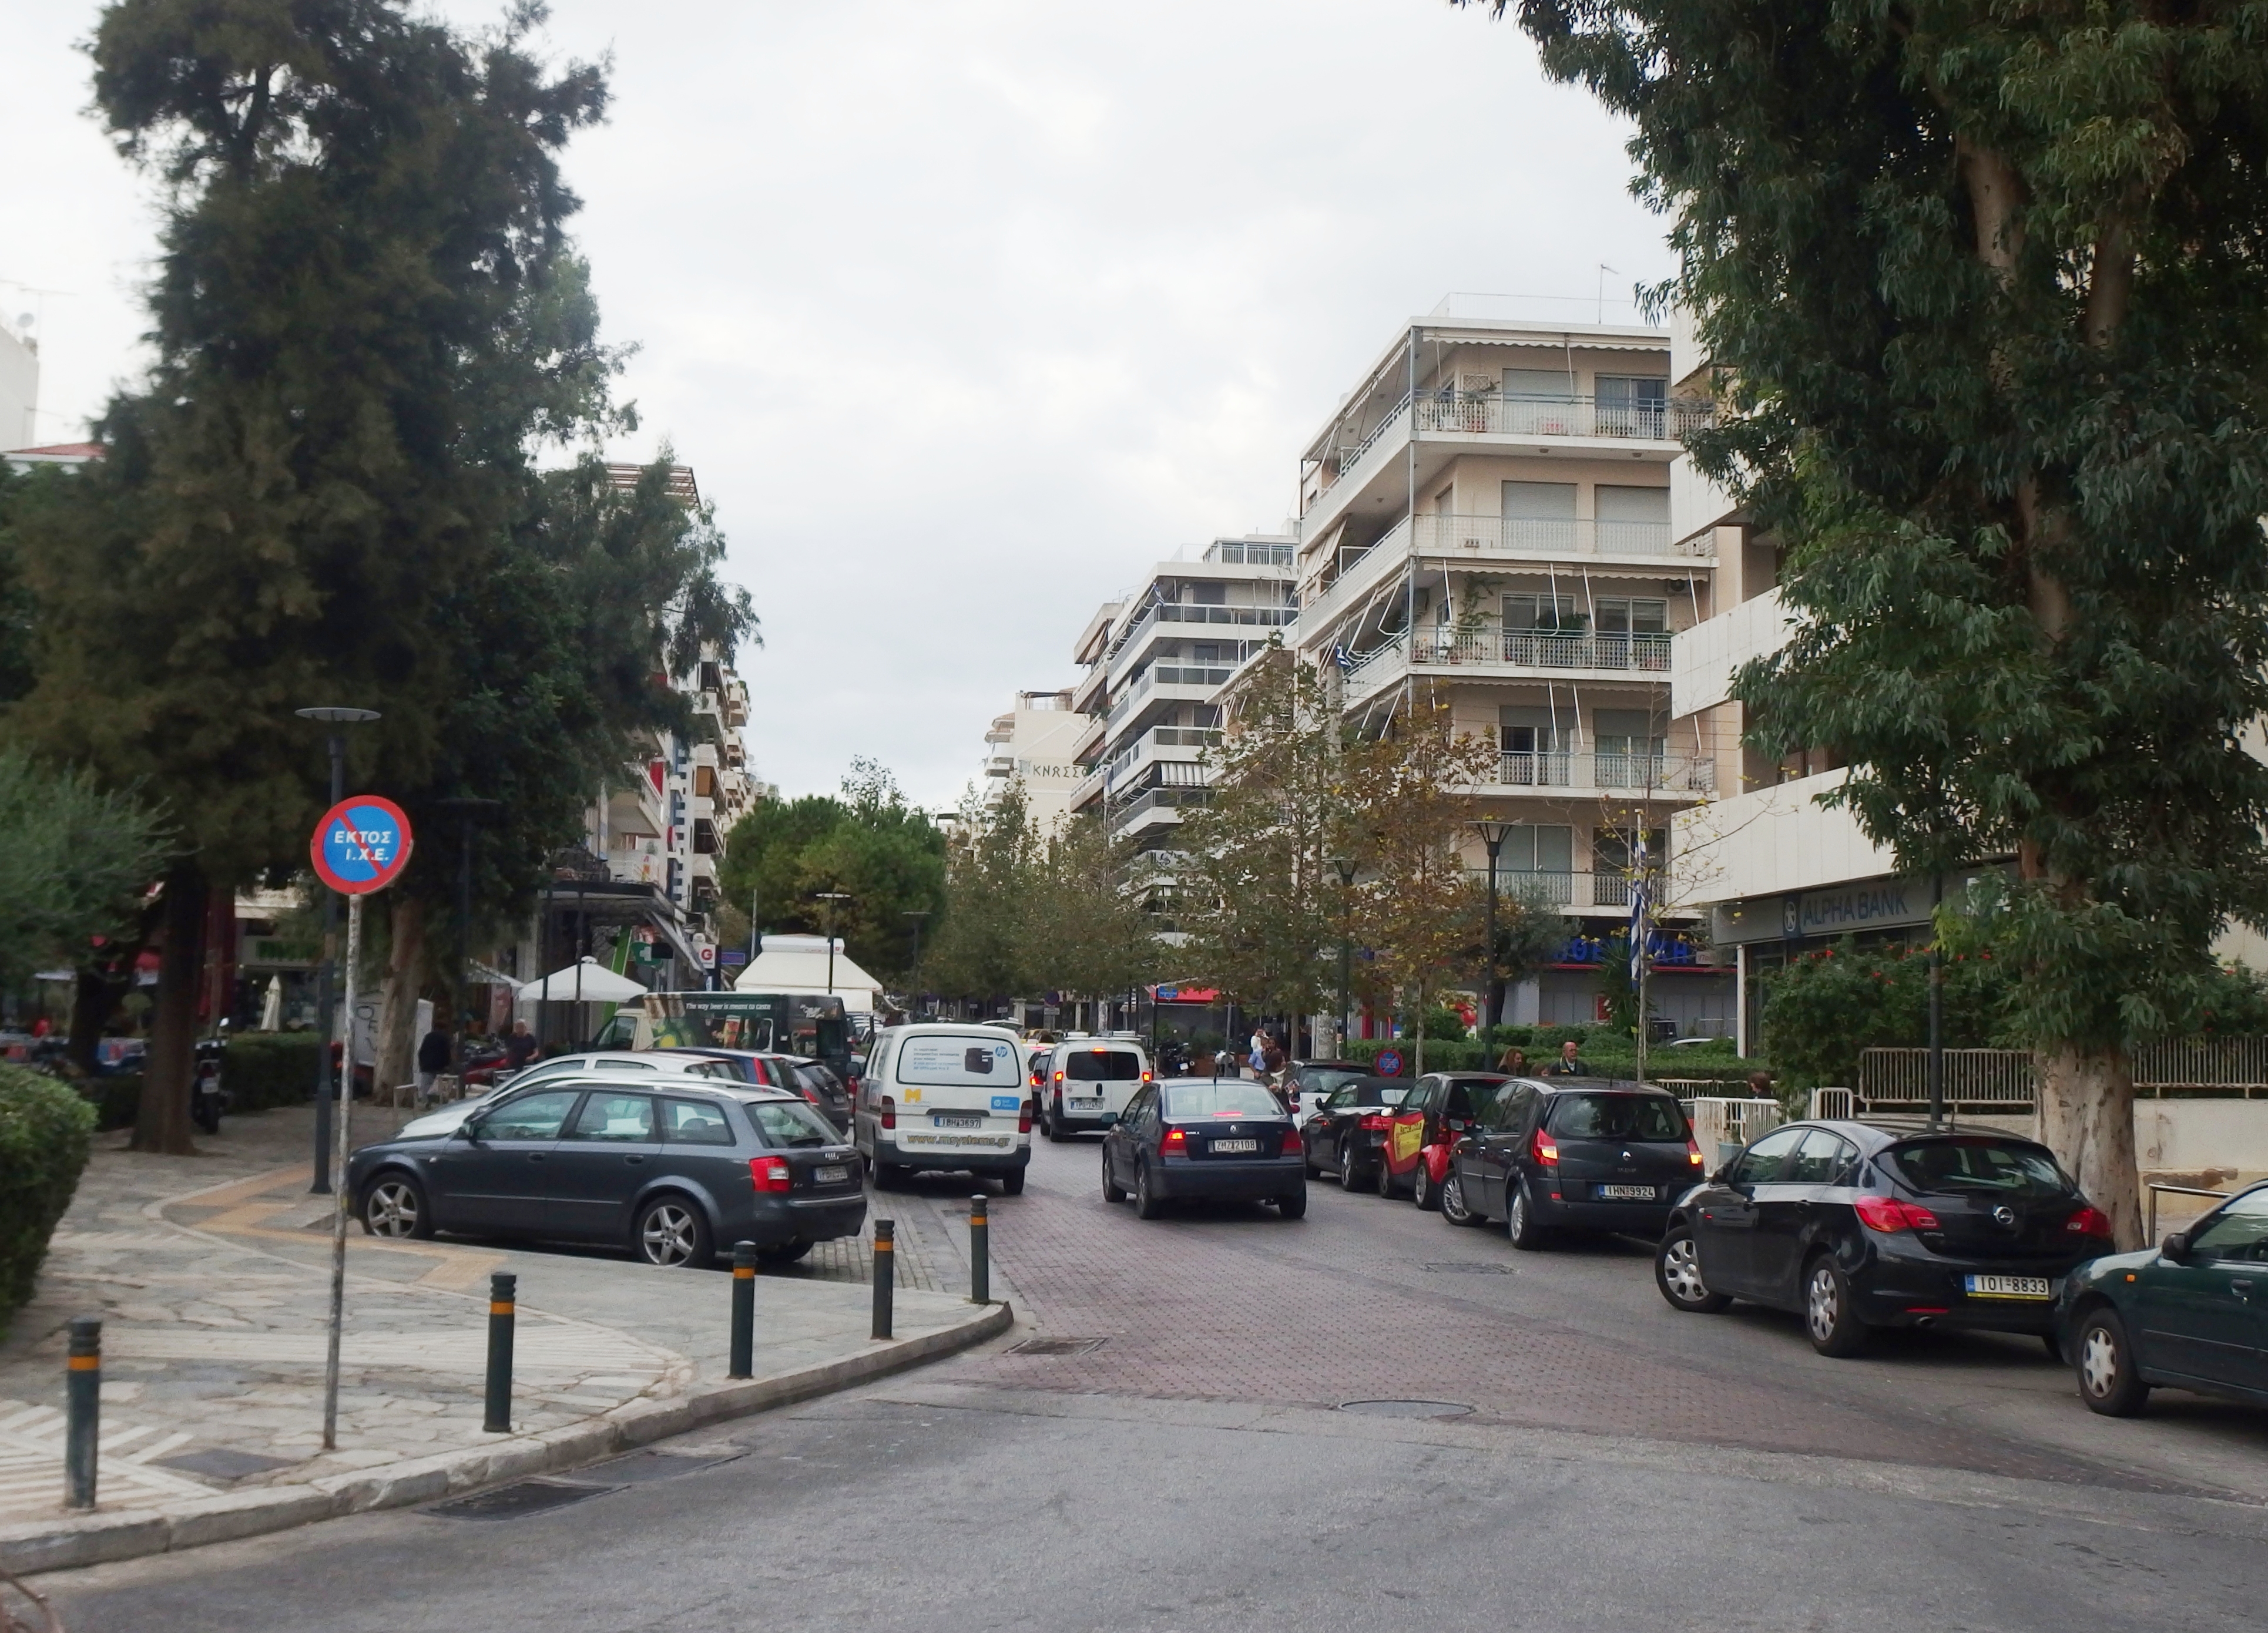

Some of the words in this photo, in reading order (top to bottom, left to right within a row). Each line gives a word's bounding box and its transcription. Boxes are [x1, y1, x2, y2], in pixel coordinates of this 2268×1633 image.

[334, 831, 392, 844] ΕΚΤΟΣ
[1803, 895, 1856, 926] ALPHA
[1858, 886, 1909, 920] BANK
[995, 1046, 1008, 1057] hp
